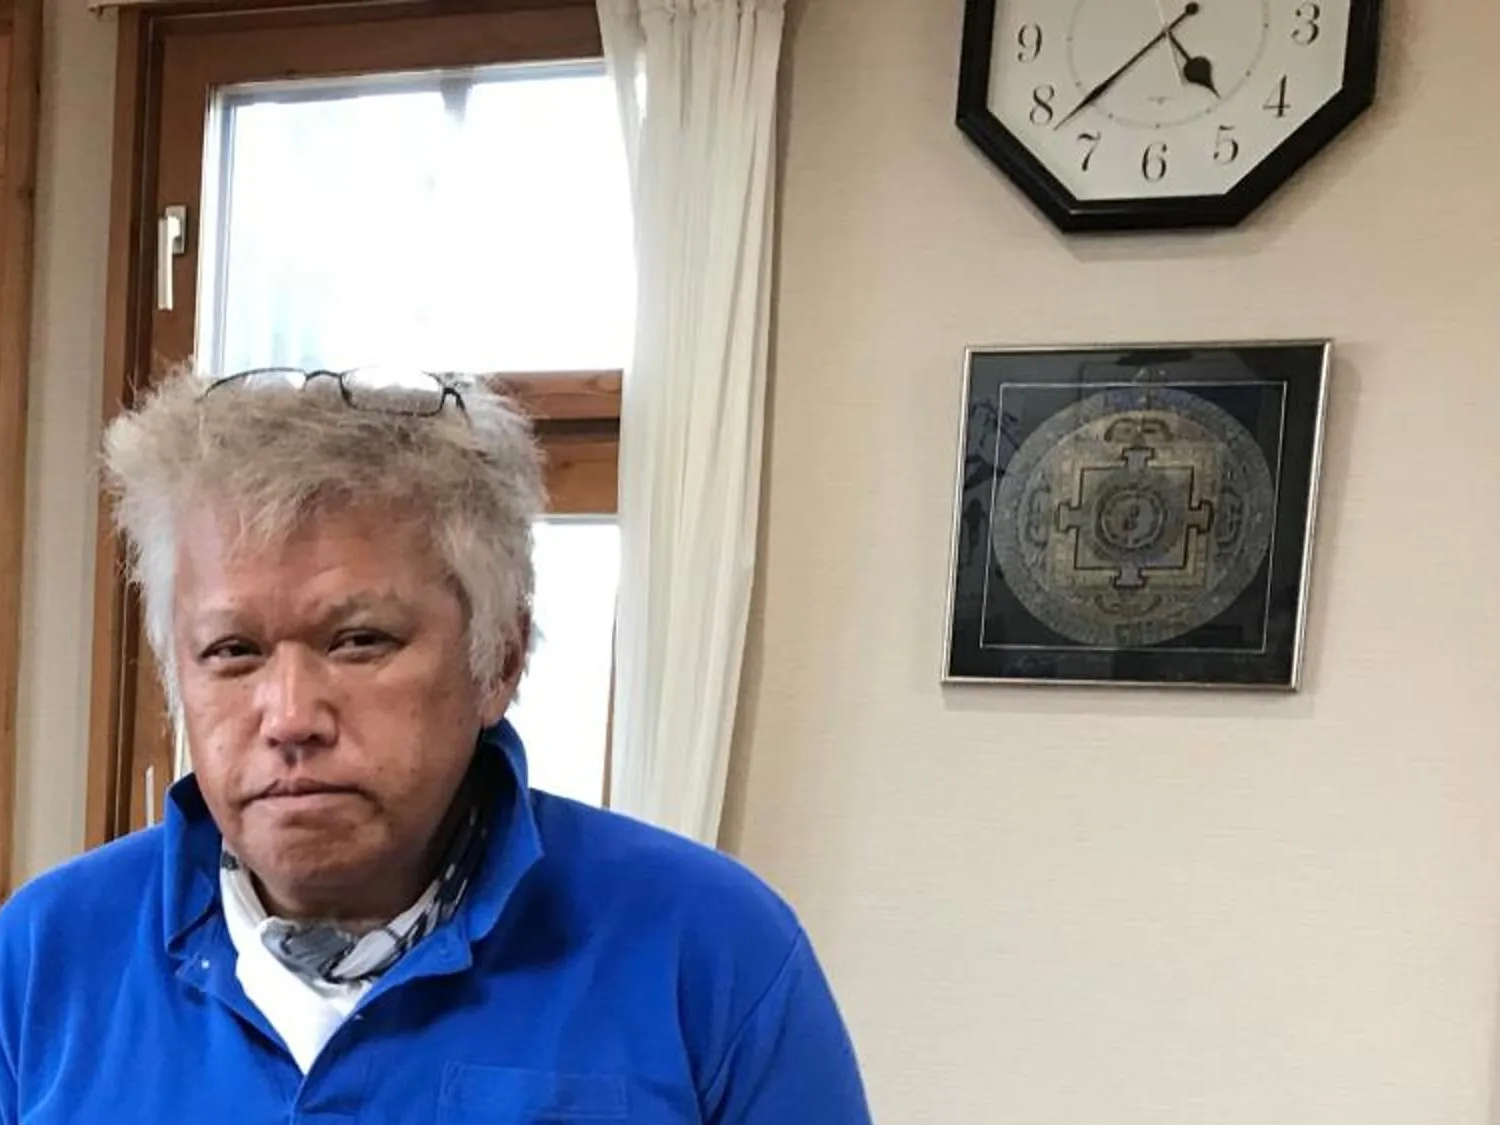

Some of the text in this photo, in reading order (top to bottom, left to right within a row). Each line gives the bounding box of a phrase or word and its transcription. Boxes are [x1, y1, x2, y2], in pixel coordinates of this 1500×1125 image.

[1017, 23, 1043, 63] 9
[1291, 4, 1321, 45] 3
[1029, 84, 1056, 126] 8
[1263, 74, 1290, 118] 4
[1076, 132, 1101, 172] 7
[1141, 143, 1168, 183] 6
[1213, 125, 1239, 164] 5
